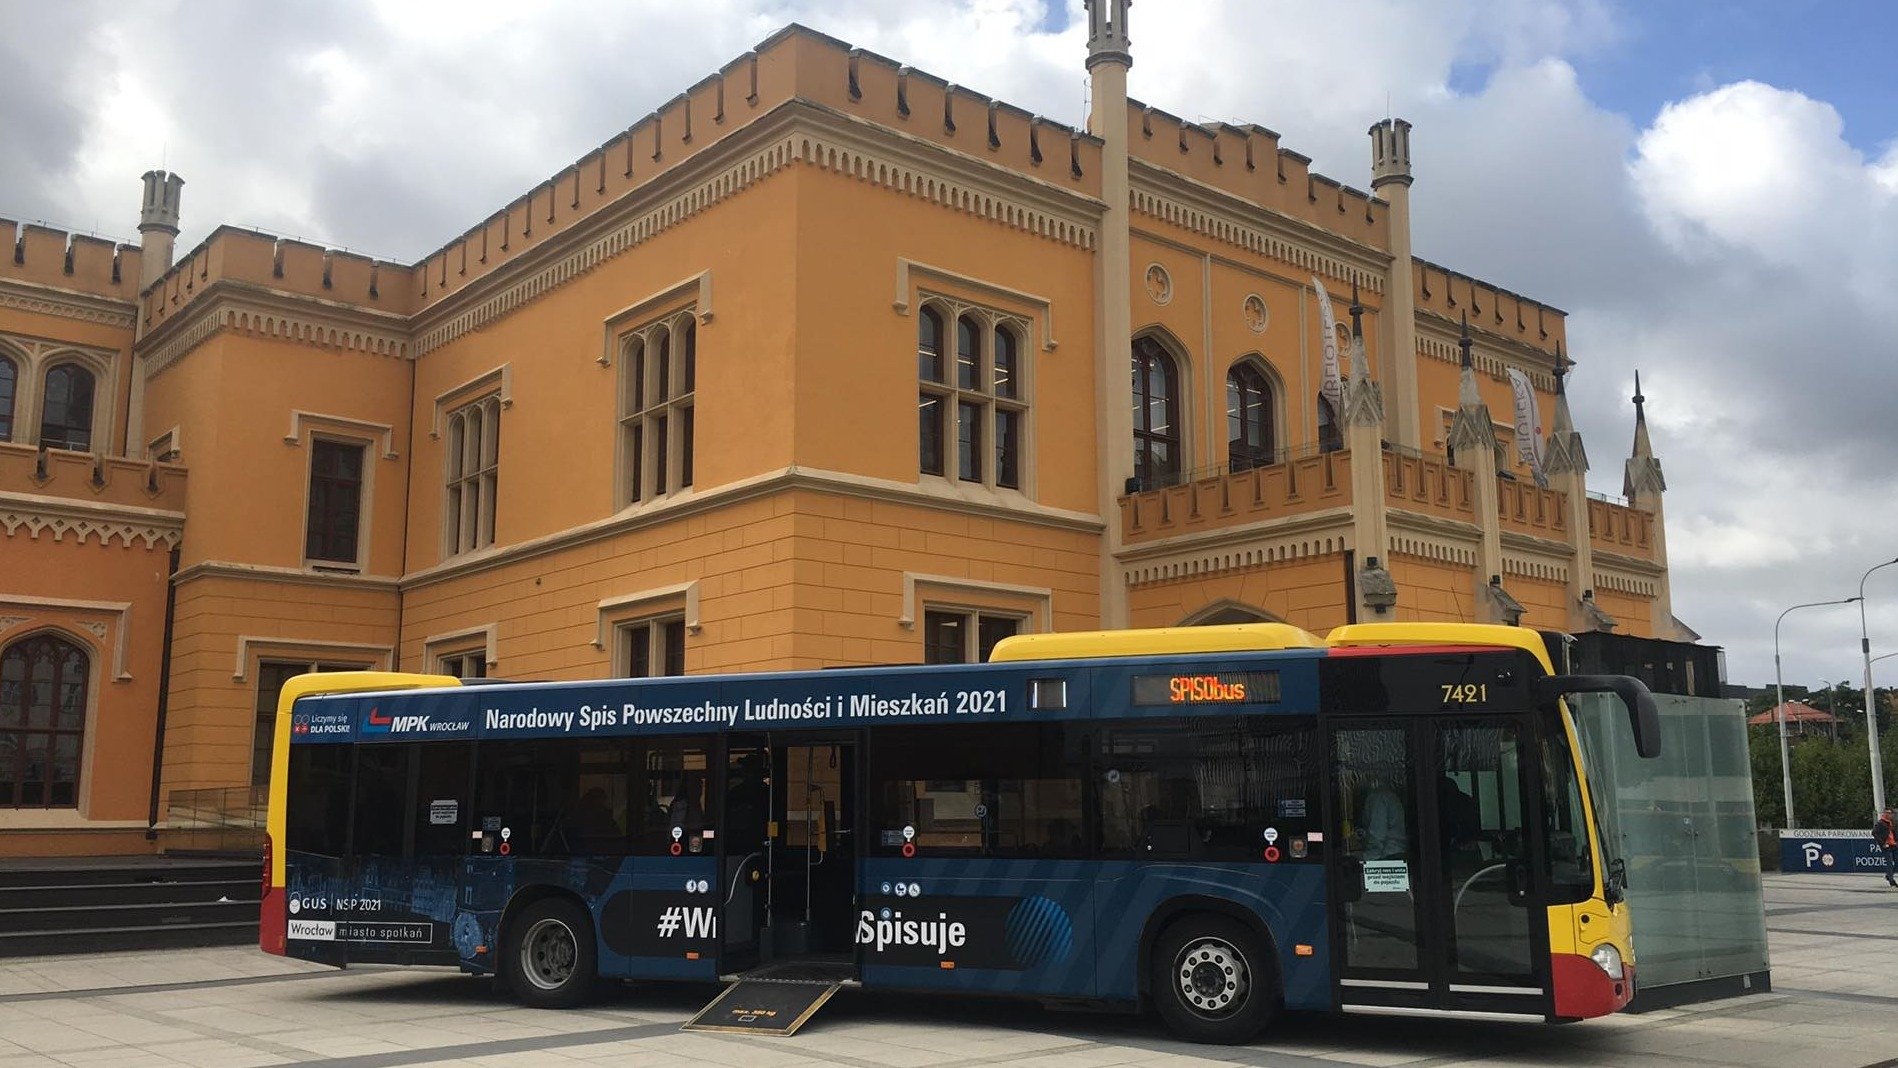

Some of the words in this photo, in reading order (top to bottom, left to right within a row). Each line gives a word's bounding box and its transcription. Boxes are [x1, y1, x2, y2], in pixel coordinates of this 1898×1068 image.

[1441, 684, 1488, 703] 7421
[485, 705, 575, 730] Narodowy
[579, 704, 617, 728] Spis
[622, 699, 738, 726] Powszechny
[744, 696, 830, 721] Ludności
[837, 696, 843, 718] i
[850, 691, 949, 717] Mieszkań
[956, 690, 1008, 714] 2021
[311, 714, 337, 725] Liczymy
[337, 713, 348, 724] się
[391, 715, 430, 732] MPK
[430, 721, 470, 732] WROCŁAW
[310, 725, 323, 733] DLA
[1793, 829, 1826, 837] GODZINA
[1869, 844, 1882, 853] PA
[1805, 848, 1820, 867] P
[1855, 857, 1889, 867] PODZIE
[302, 897, 327, 910] GUS
[336, 898, 358, 911] NSP
[359, 899, 382, 911] 2021
[291, 922, 334, 937] Wrocław
[338, 926, 376, 938] miasto
[379, 928, 423, 939] spotkań
